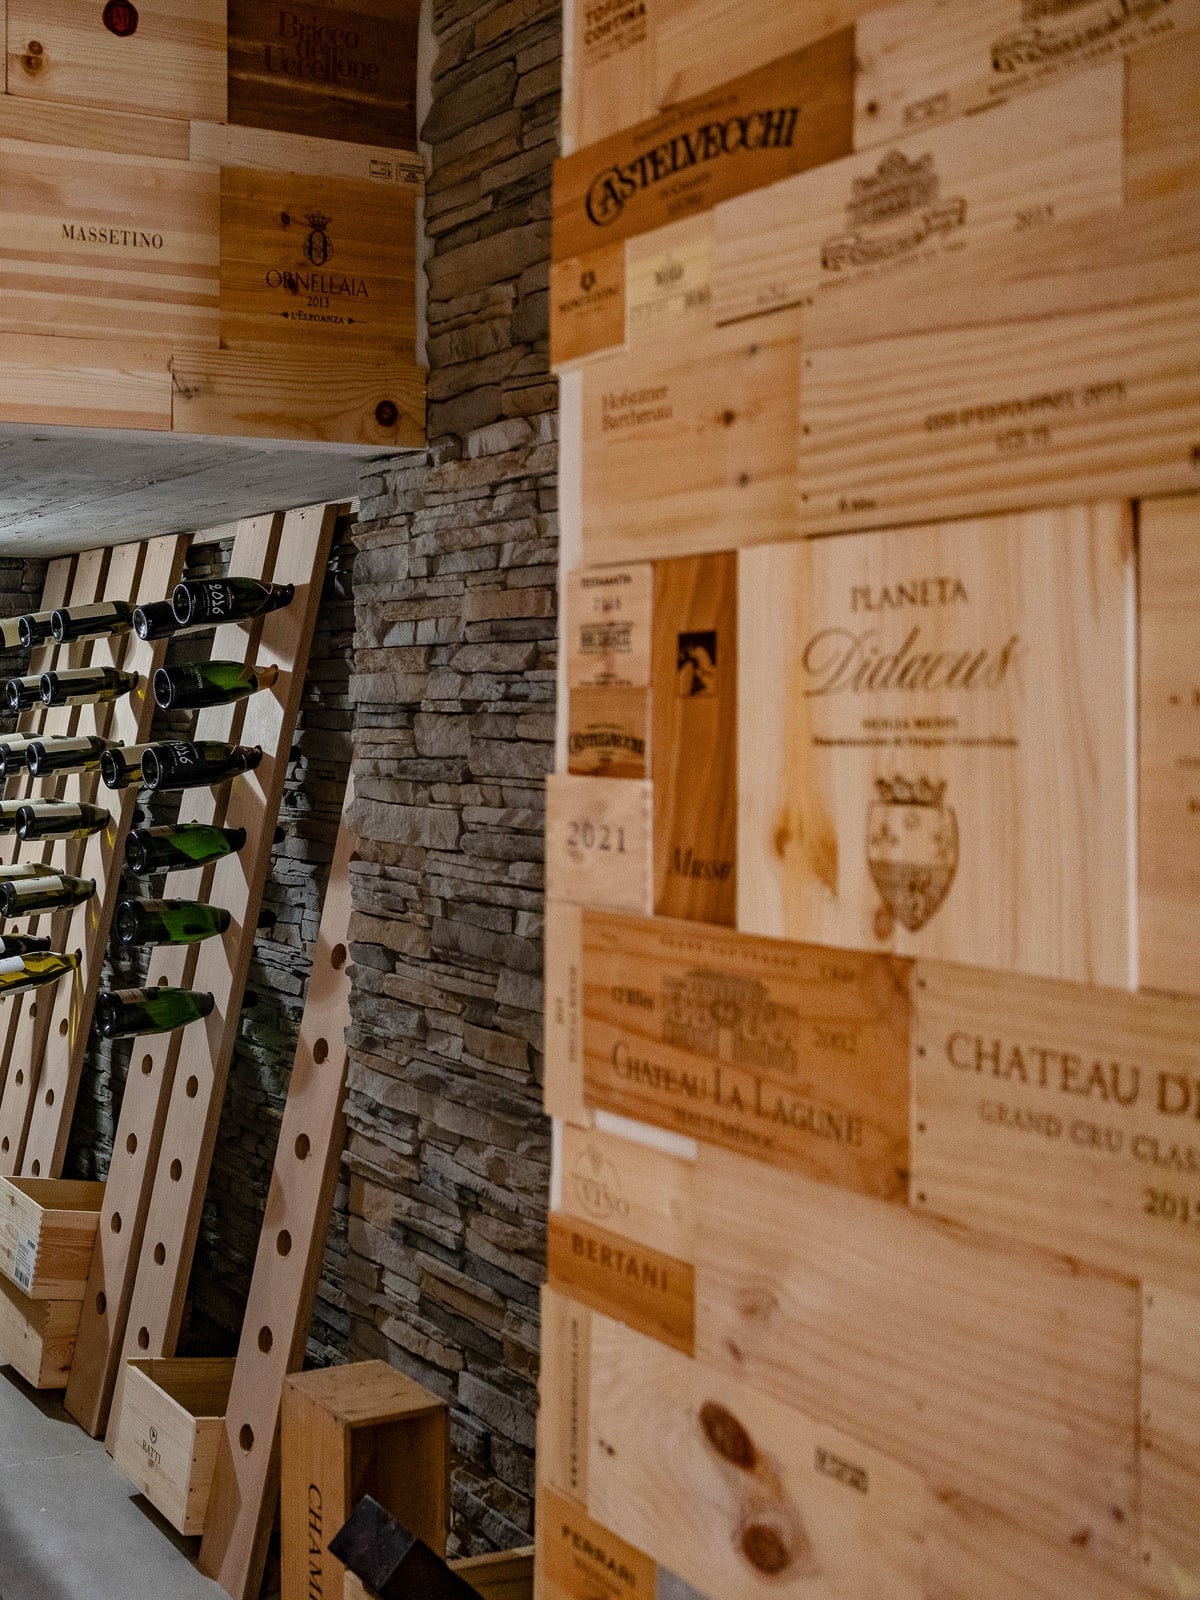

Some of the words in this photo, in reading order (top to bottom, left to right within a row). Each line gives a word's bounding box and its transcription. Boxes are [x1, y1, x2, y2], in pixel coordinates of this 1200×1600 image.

[279, 10, 360, 50] Bricco
[62, 224, 163, 249] MASSETINO
[266, 269, 369, 297] ORNELLAIA
[307, 296, 330, 308] 2013
[208, 583, 225, 615] 2016
[852, 576, 970, 612] PLANETA
[566, 819, 627, 854] 2021
[945, 1030, 1141, 1109] CHATEAU
[1157, 1068, 1200, 1121] D
[753, 1076, 865, 1147] LAGUNE
[976, 1099, 1064, 1140] GRAND
[1068, 1118, 1124, 1154] CRU
[571, 1232, 668, 1294] BERTANI
[142, 1439, 161, 1466] RATTI
[561, 1524, 637, 1589] FERRARI
